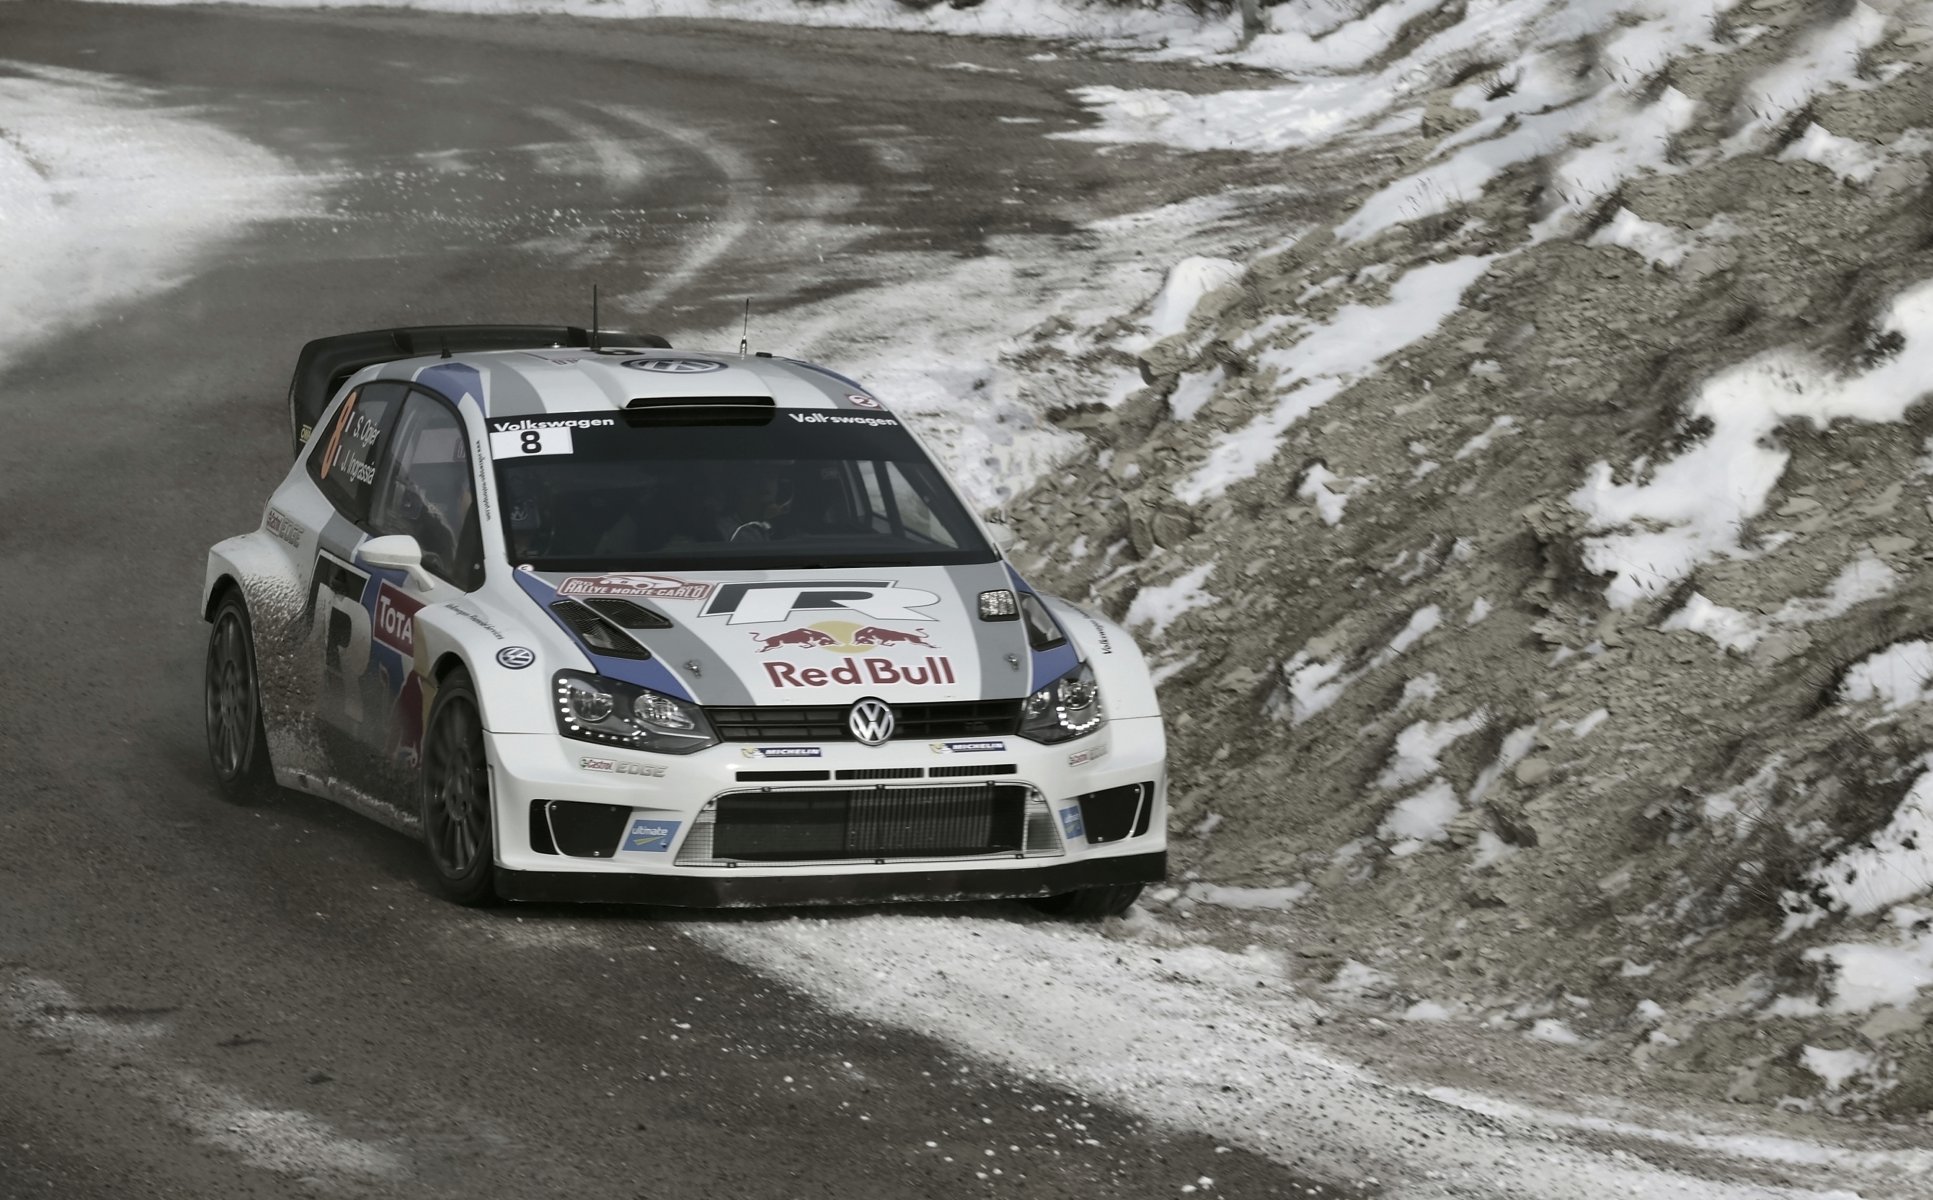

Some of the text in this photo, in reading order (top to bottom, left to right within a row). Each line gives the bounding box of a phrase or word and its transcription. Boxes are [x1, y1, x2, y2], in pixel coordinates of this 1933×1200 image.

[494, 418, 615, 432] Volkswagen
[788, 412, 898, 427] Volkswagen
[321, 391, 357, 480] 8
[361, 419, 381, 448] Ogier
[520, 430, 542, 454] 8
[565, 582, 611, 594] RALLYE
[380, 594, 412, 644] TOTA
[762, 656, 955, 688] Red Bull
[765, 747, 820, 756] MICHELIN
[952, 741, 1004, 750] MICHELIN
[586, 759, 668, 778] Castrol EDGE
[632, 825, 669, 836] ultimate
